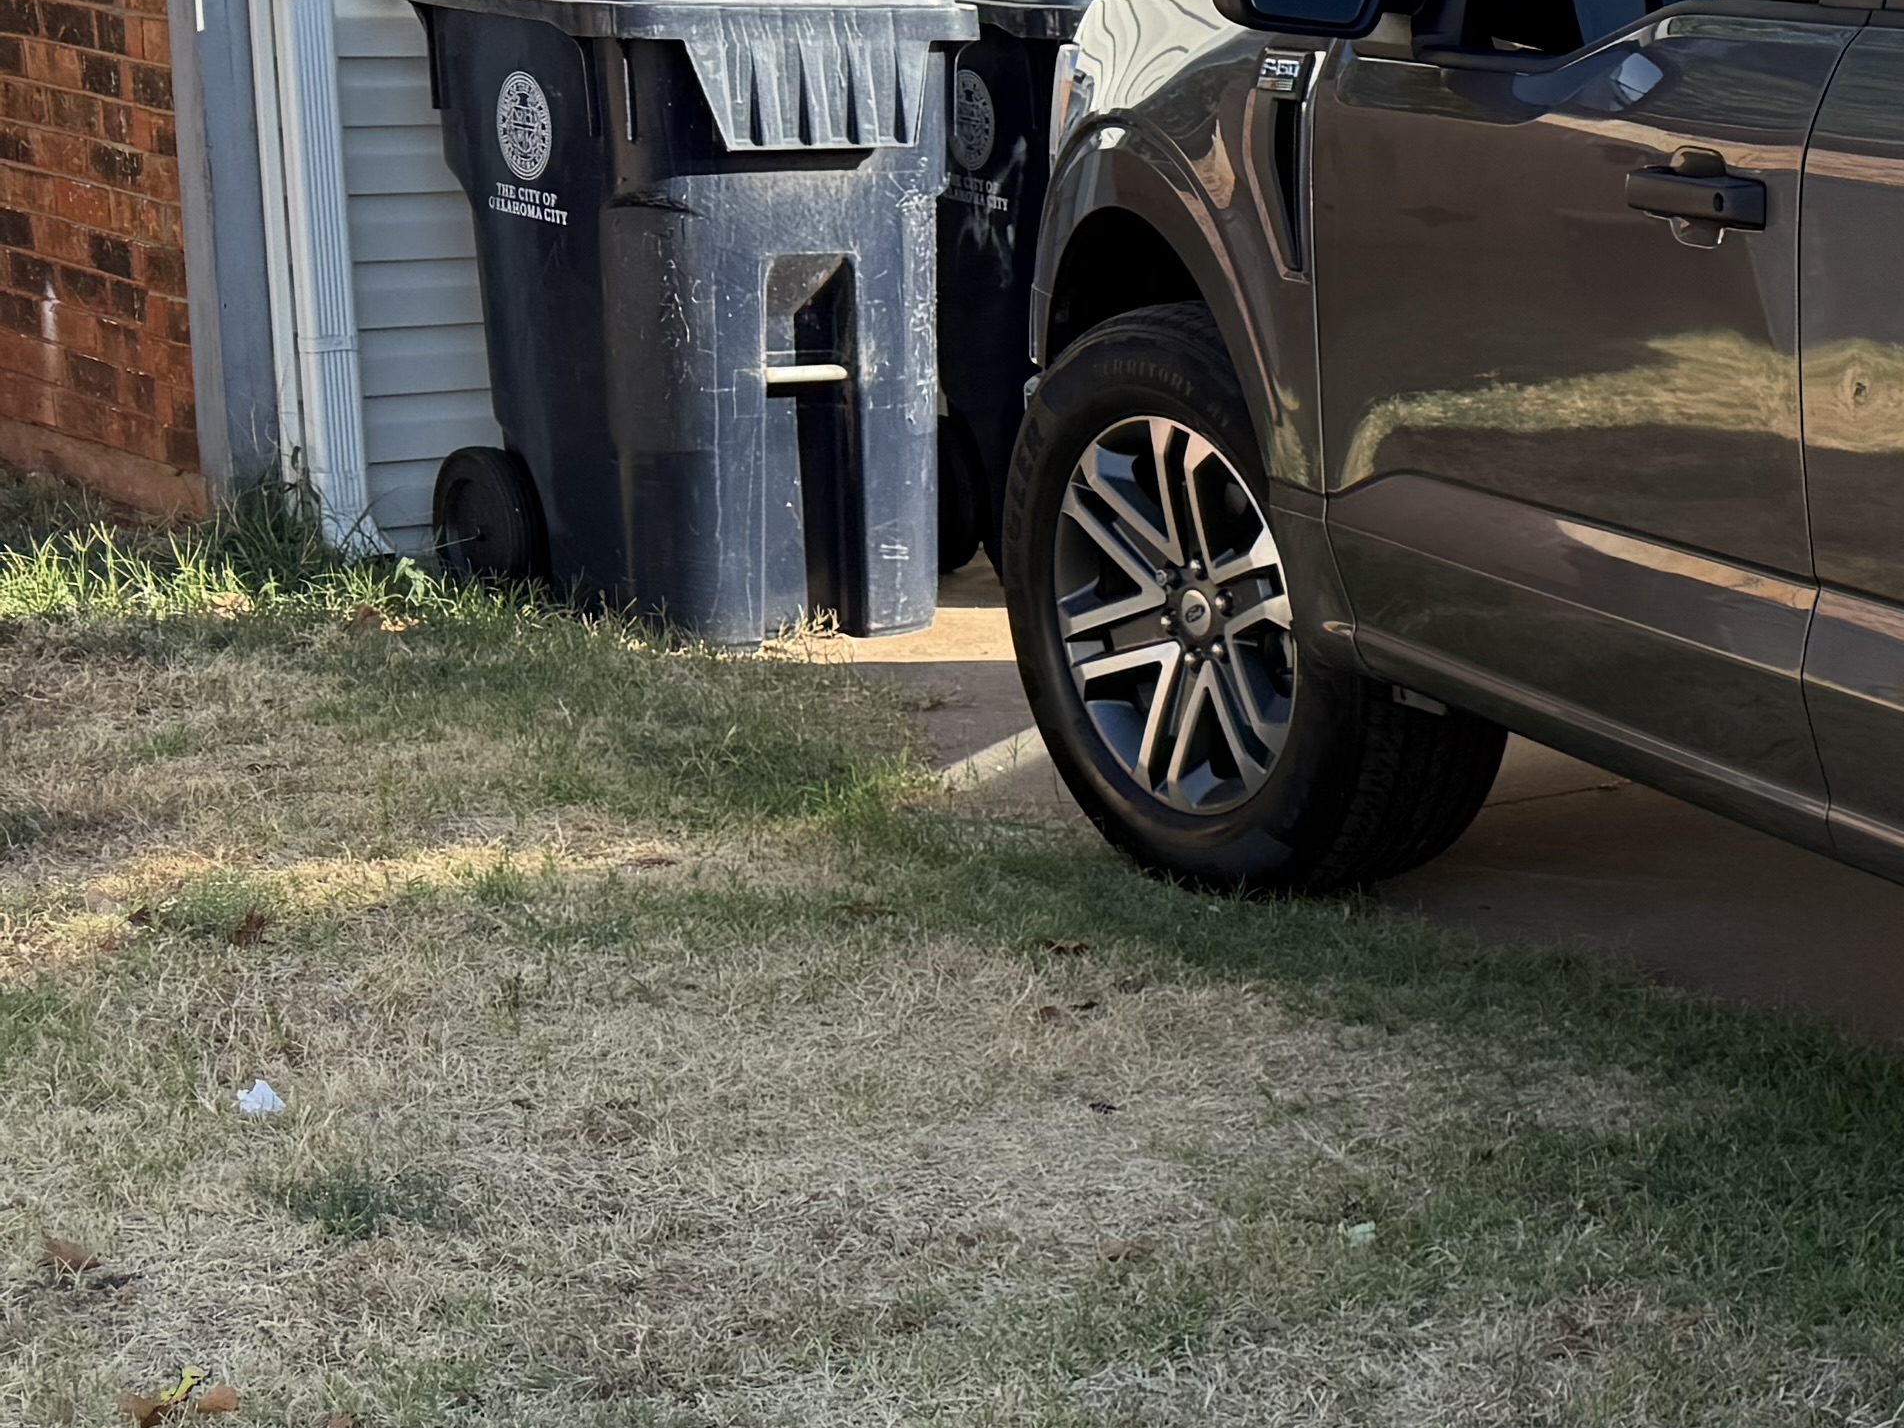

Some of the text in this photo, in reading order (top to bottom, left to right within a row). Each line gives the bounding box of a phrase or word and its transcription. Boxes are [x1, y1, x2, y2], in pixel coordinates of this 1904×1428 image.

[496, 181, 558, 207] THE CITY OF
[488, 195, 568, 226] OKLAHOMA CITY
